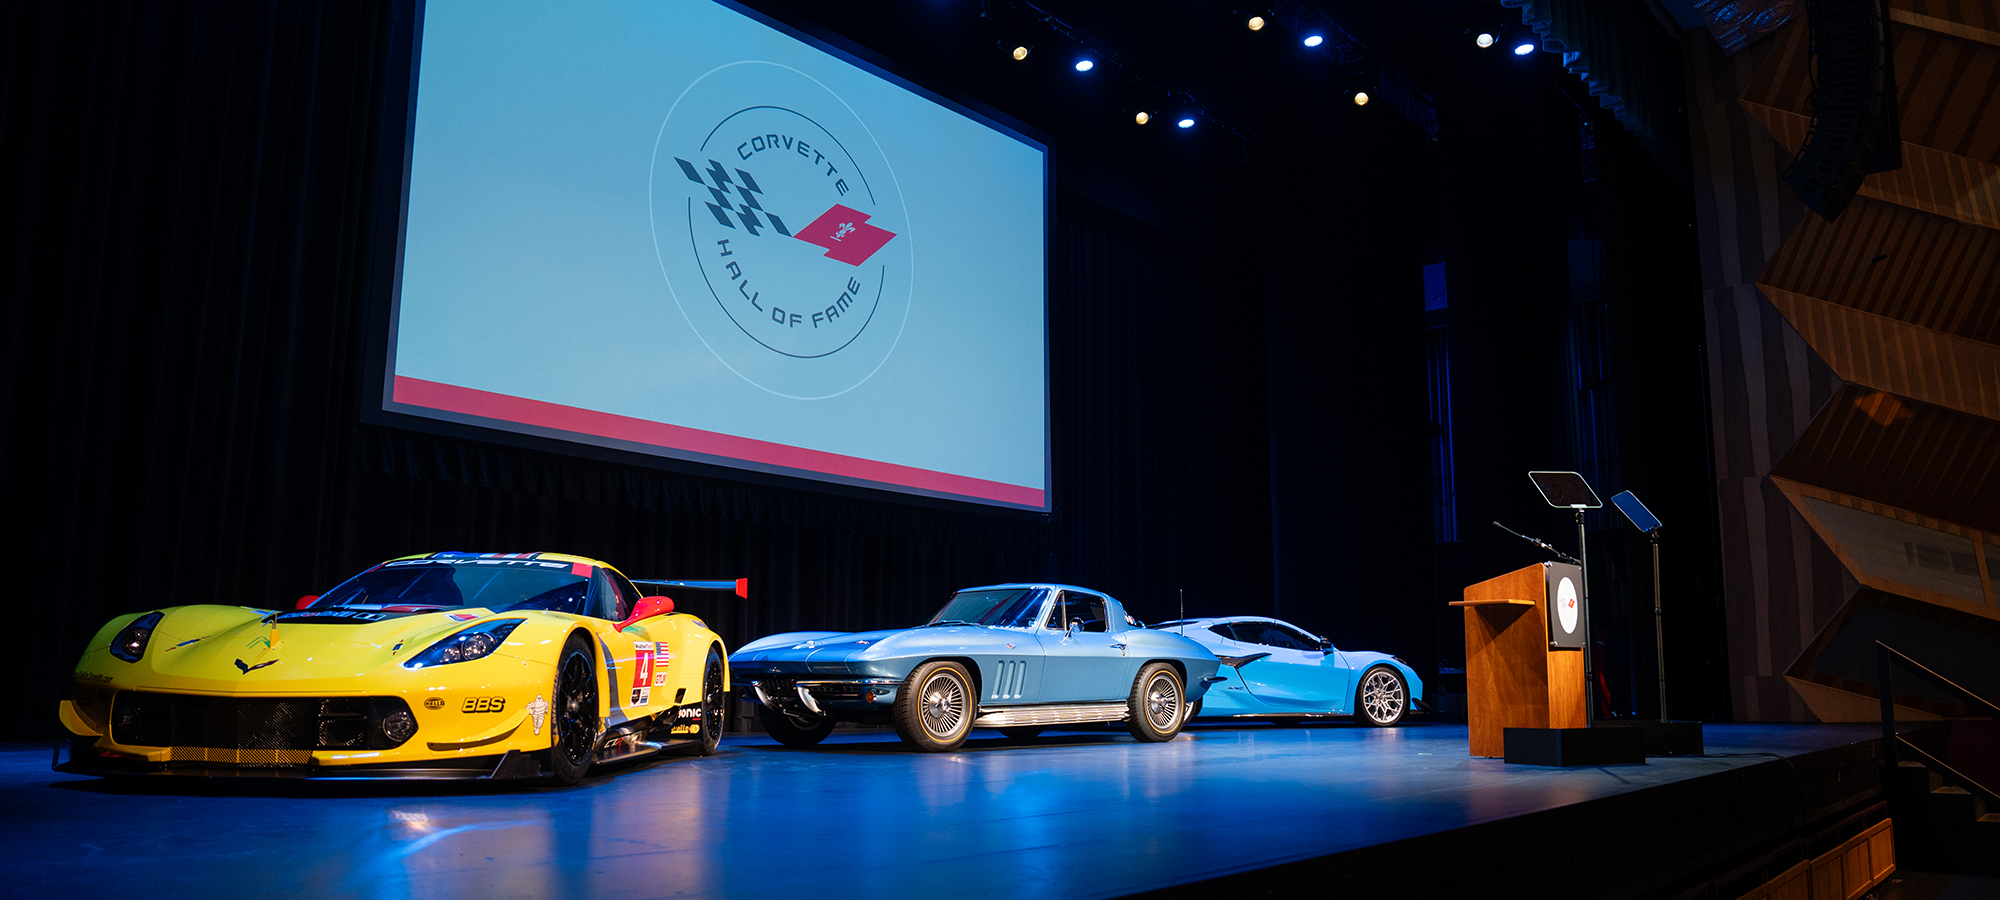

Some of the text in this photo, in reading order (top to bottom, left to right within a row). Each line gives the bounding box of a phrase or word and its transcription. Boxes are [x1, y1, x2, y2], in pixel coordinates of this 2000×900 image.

[737, 134, 849, 196] CORVETTE
[717, 239, 860, 328] HALL OF FAME
[385, 559, 569, 569] CORVETTE
[640, 652, 648, 686] 4
[462, 696, 506, 713] BBS
[552, 669, 560, 724] MICHELIN
